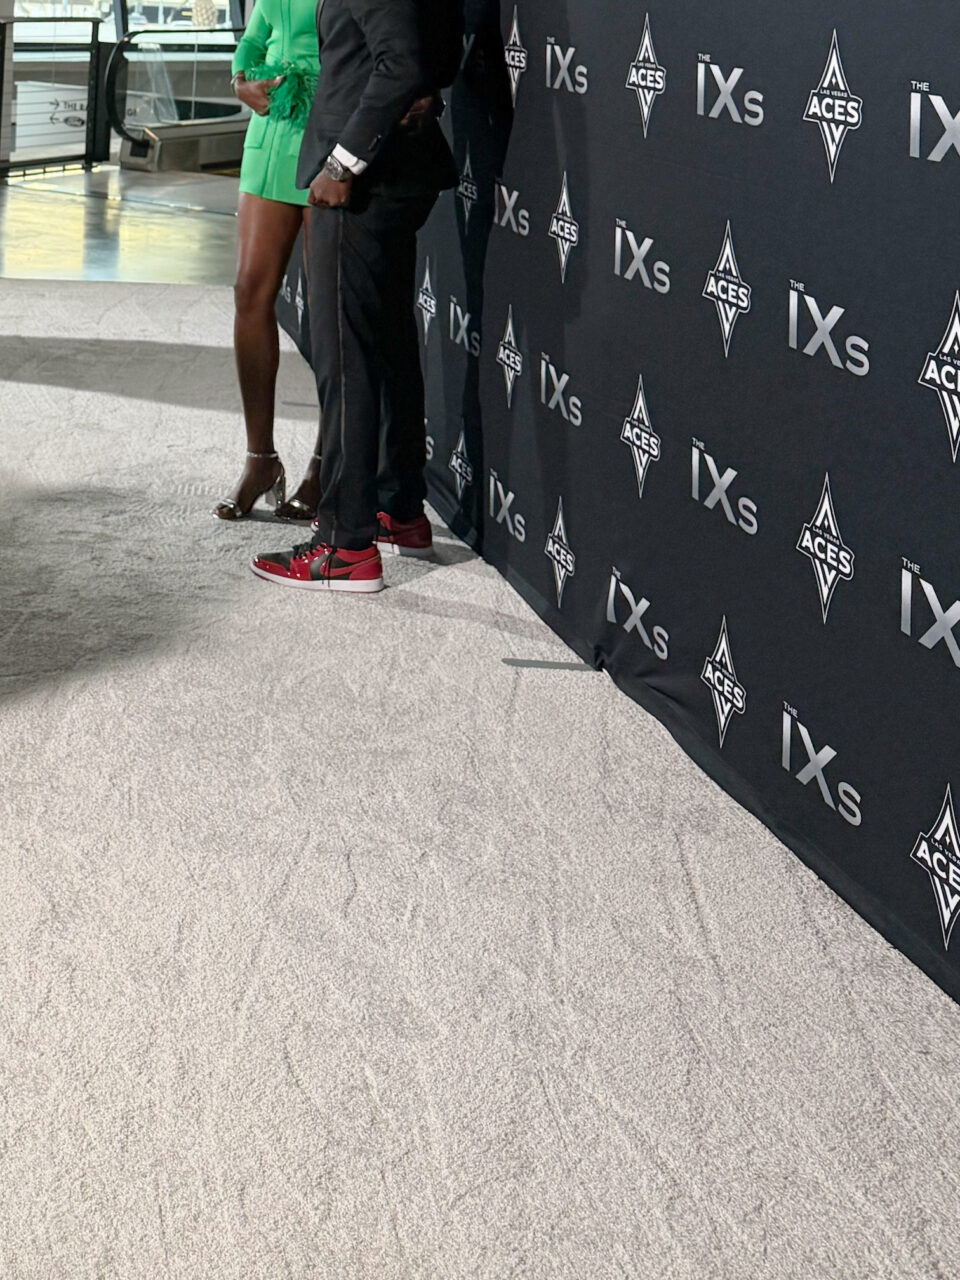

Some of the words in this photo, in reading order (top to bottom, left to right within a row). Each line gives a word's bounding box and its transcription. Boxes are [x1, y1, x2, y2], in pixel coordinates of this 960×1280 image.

[546, 44, 587, 94] IXs
[629, 67, 664, 89] ACES
[698, 53, 711, 62] THE
[697, 62, 764, 127] IXs
[911, 81, 929, 91] THE
[808, 96, 859, 123] ACES
[909, 92, 960, 162] IX
[494, 184, 529, 236] IXs
[551, 218, 577, 242] ACES
[614, 227, 670, 294] IXs
[707, 277, 748, 308] ACES
[790, 279, 805, 291] THE
[450, 302, 480, 357] IXs
[789, 290, 870, 376] IXs
[499, 347, 521, 371] ACES
[940, 354, 951, 362] LAS
[541, 360, 582, 427] IXs
[624, 423, 658, 456] ACES
[451, 454, 472, 482] ACES
[490, 475, 525, 542] IXs
[692, 446, 758, 535] IXs
[548, 538, 573, 572] ACES
[802, 530, 851, 574] ACES
[902, 556, 920, 574] THE
[607, 575, 669, 660] IXs
[901, 568, 960, 669] IX
[705, 664, 743, 709] ACES
[783, 701, 798, 718] THE
[782, 711, 862, 826] IXs
[917, 840, 960, 892] ACE
